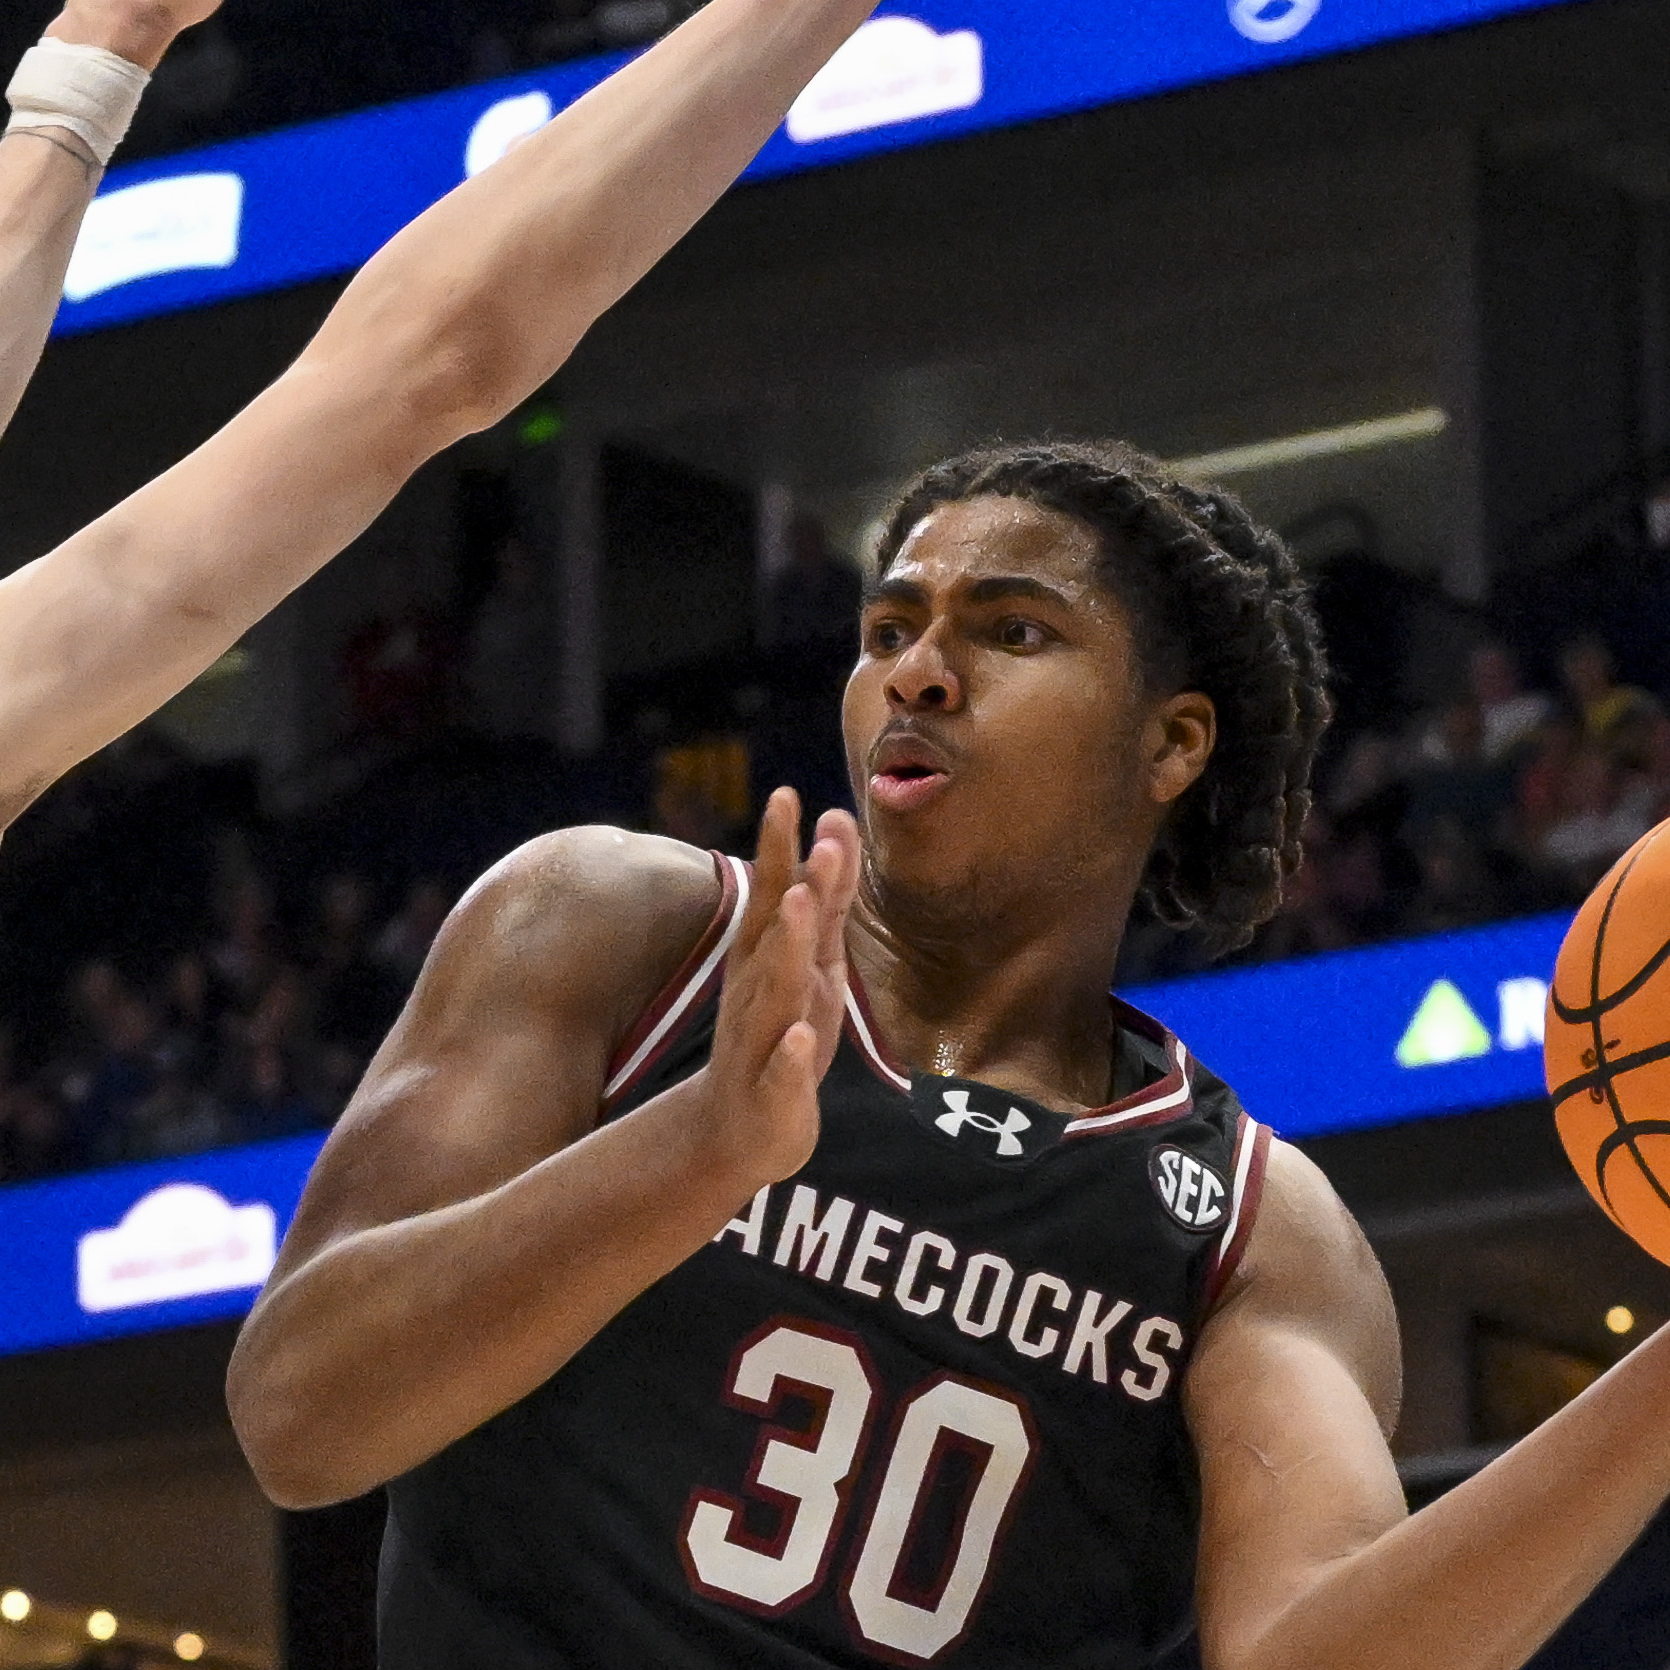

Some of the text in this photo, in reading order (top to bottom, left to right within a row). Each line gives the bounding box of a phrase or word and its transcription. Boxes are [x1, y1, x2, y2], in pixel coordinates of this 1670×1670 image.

[712, 1183, 1182, 1401] AMECOCKS
[1157, 1149, 1224, 1227] SEC
[684, 1318, 1036, 1666] 30
